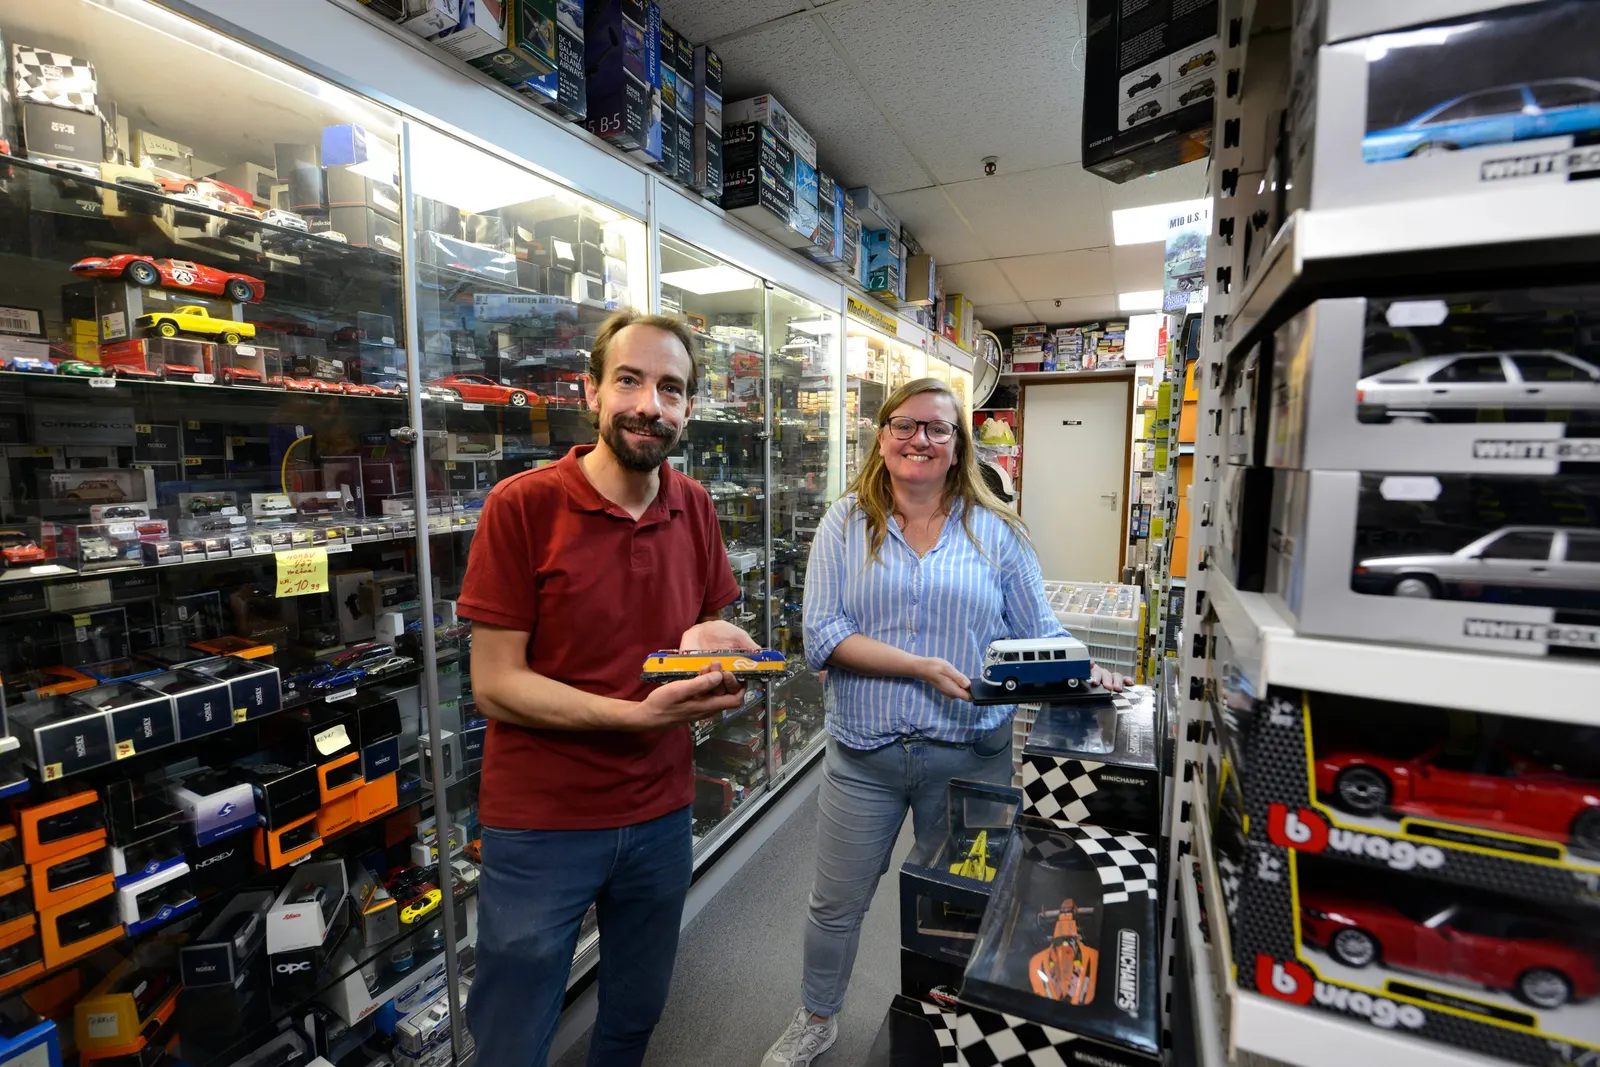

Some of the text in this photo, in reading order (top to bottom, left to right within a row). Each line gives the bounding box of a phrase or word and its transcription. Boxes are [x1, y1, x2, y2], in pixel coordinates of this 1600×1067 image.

[558, 34, 571, 48] DC-4
[559, 50, 582, 70] ICELAND
[559, 59, 584, 80] AIRWAYS
[600, 112, 620, 133] B-5
[747, 125, 755, 142] 5
[747, 167, 755, 185] 5
[1169, 216, 1185, 229] M10
[1187, 212, 1201, 224] U.S.
[174, 269, 193, 286] 23
[878, 275, 885, 288] 2
[203, 701, 212, 723] NOREV
[144, 716, 153, 739] NOREV
[75, 734, 87, 758] NOREV
[375, 755, 391, 766] NOREV
[1101, 774, 1147, 786] MINICHAMPS
[195, 849, 234, 870] NOREV
[195, 965, 216, 973] NOREV
[276, 961, 312, 975] opc
[1118, 931, 1137, 1010] MINICHAMPS
